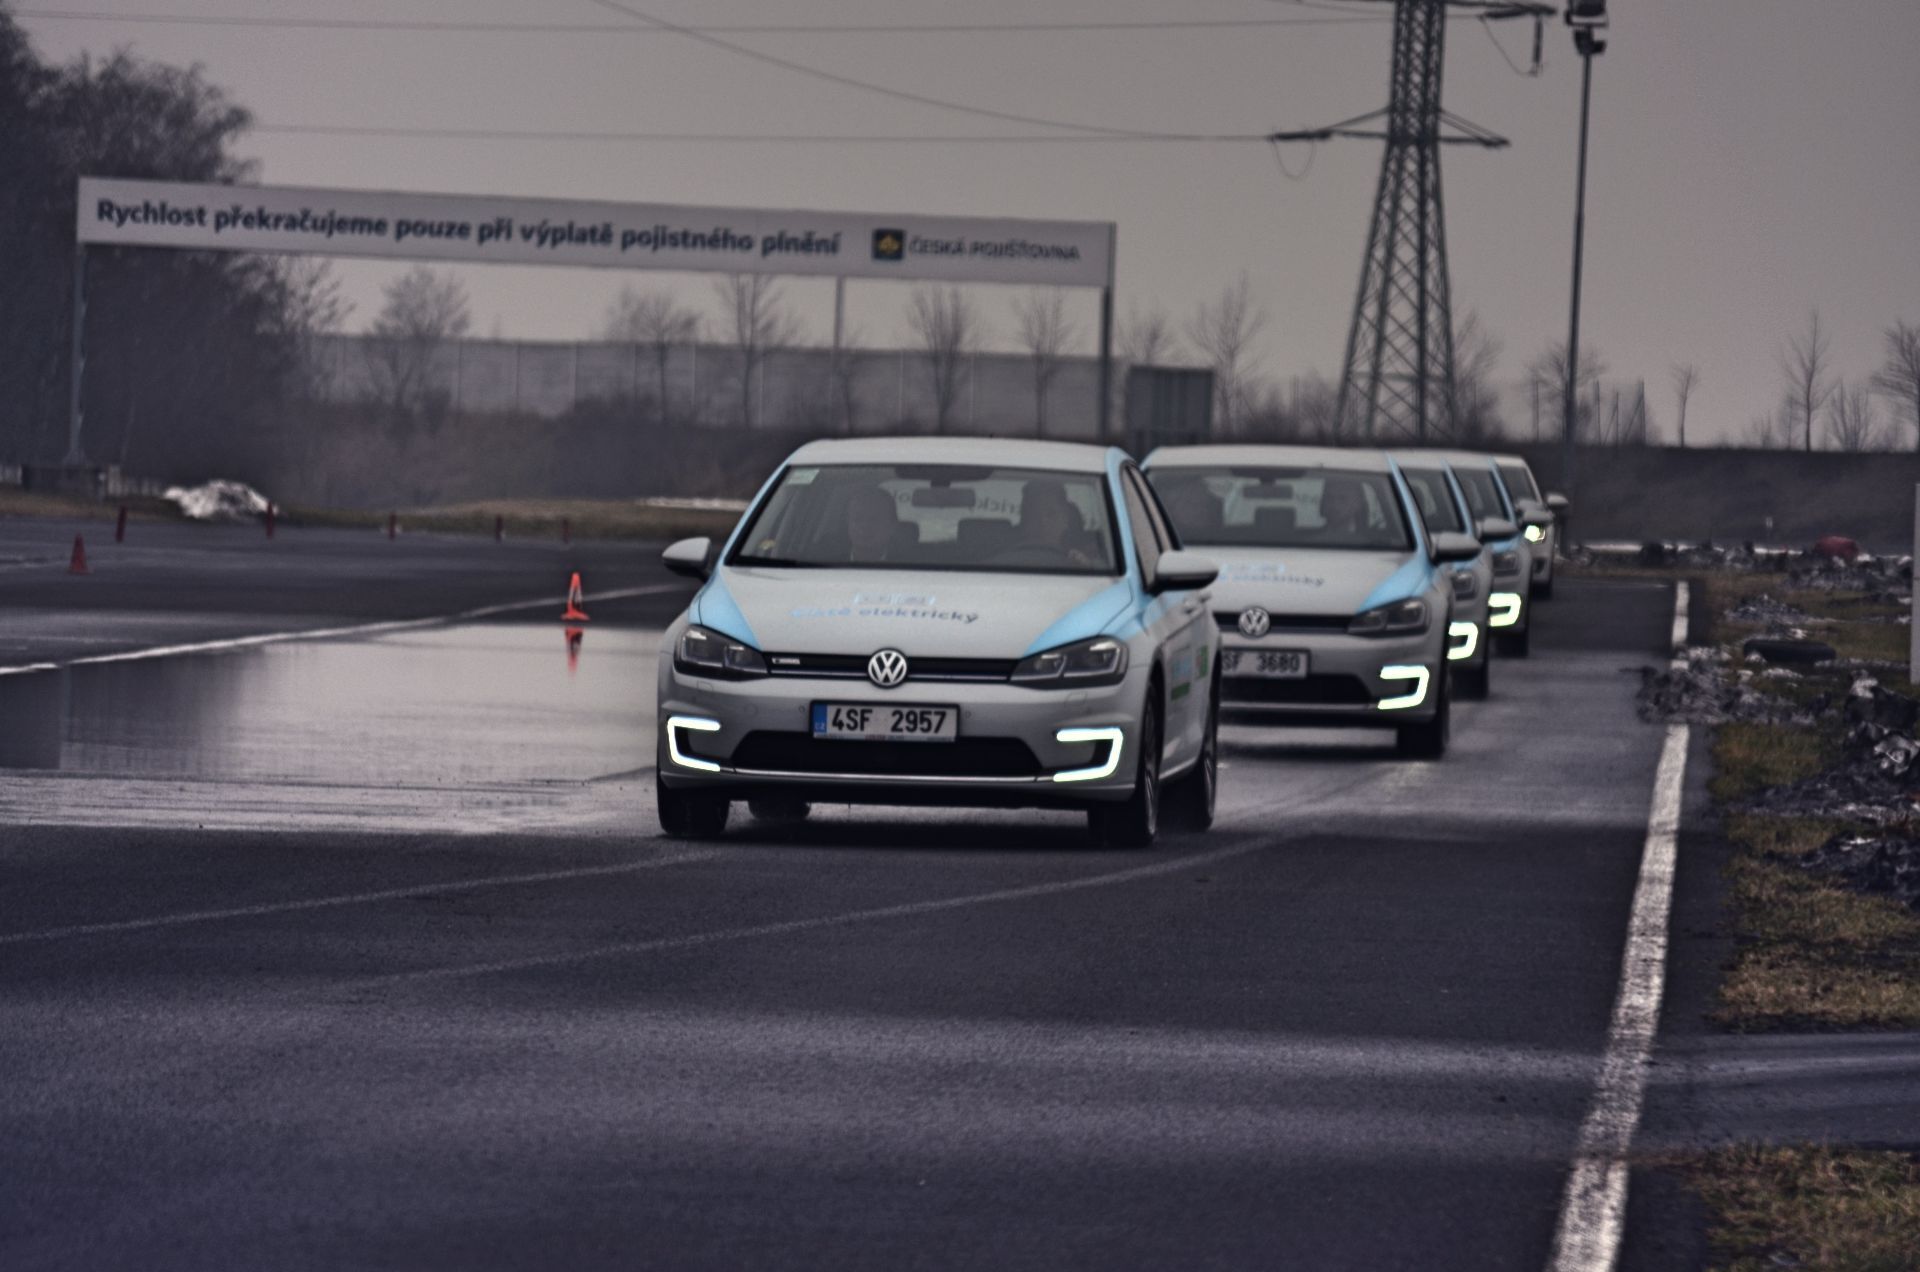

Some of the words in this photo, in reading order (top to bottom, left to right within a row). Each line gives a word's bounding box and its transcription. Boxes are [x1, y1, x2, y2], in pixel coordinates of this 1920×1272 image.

[98, 197, 207, 228] Rychlost
[215, 206, 388, 238] překračujeme
[395, 219, 470, 242] pouze
[478, 217, 513, 245] při
[520, 219, 613, 248] výplatě
[621, 225, 753, 254] pojistného
[761, 232, 842, 257] plnění
[909, 235, 964, 256] ČESKÁ
[867, 650, 909, 687] VW
[1221, 653, 1241, 671] SF
[831, 707, 874, 732] 4SF
[891, 709, 948, 736] 2957
